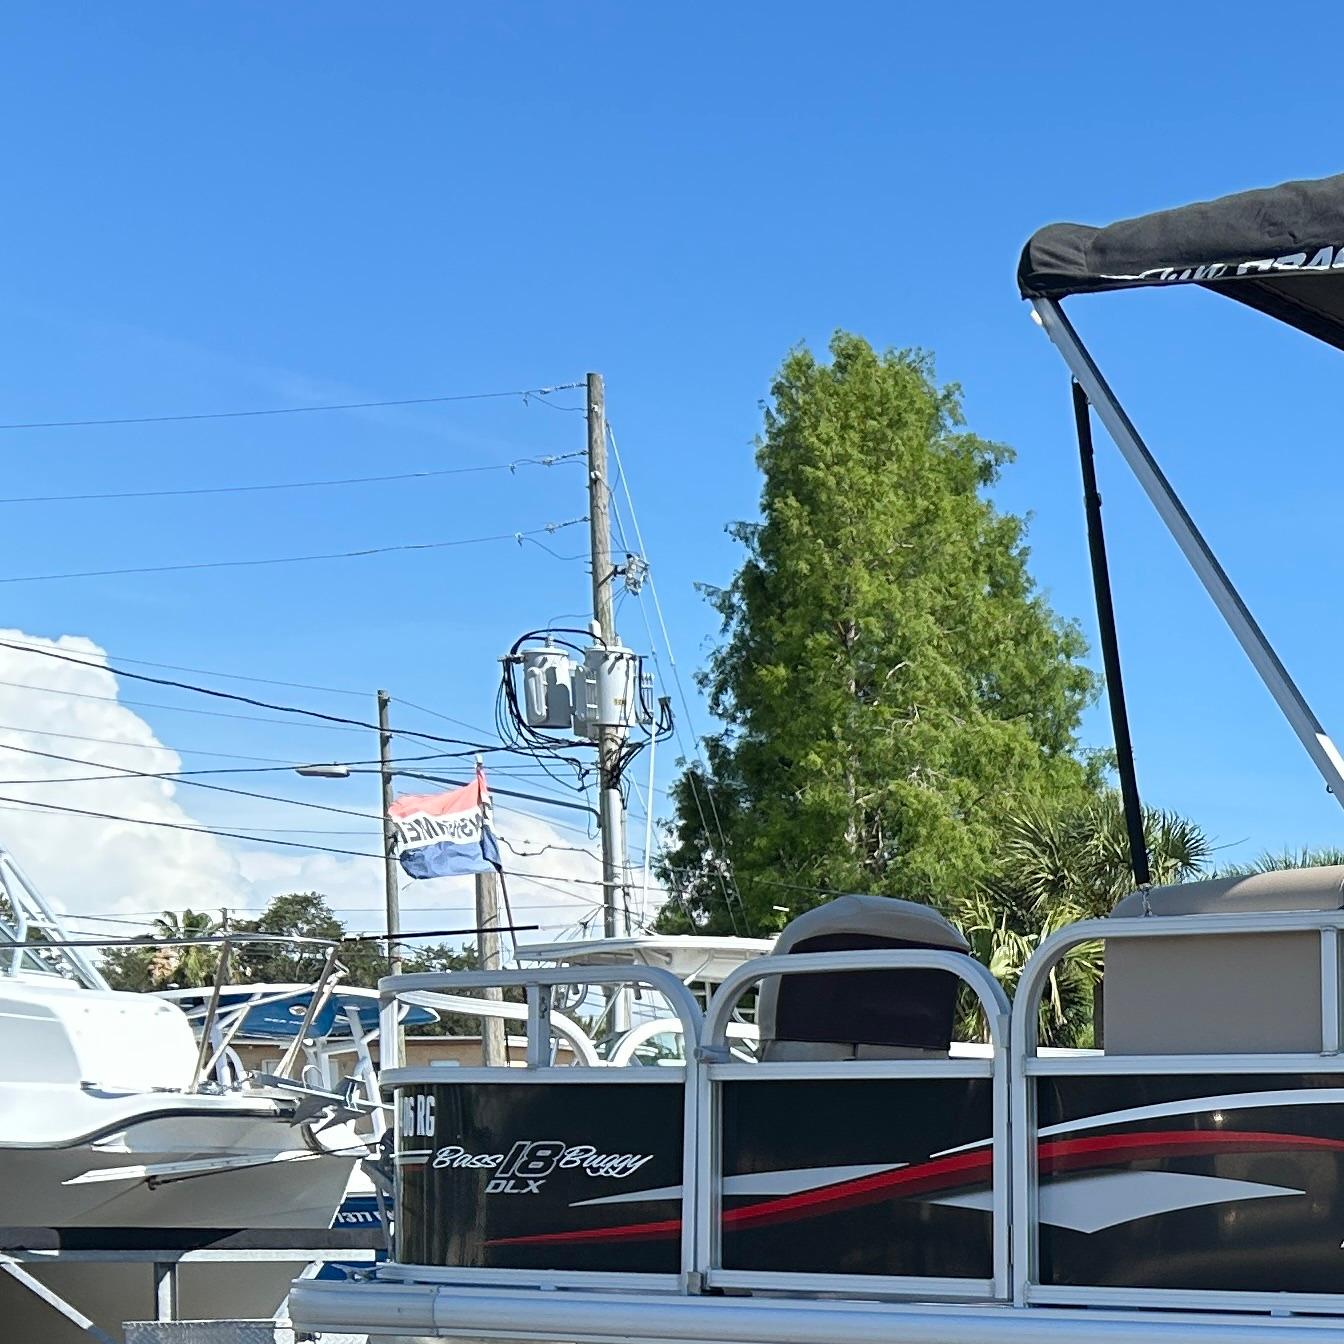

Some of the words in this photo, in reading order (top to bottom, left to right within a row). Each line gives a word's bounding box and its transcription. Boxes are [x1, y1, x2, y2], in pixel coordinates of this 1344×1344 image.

[416, 1094, 436, 1137] RG
[432, 1146, 504, 1169] Bass
[494, 1141, 566, 1177] 18
[558, 1146, 654, 1178] Buggy
[484, 1179, 546, 1194] DLX
